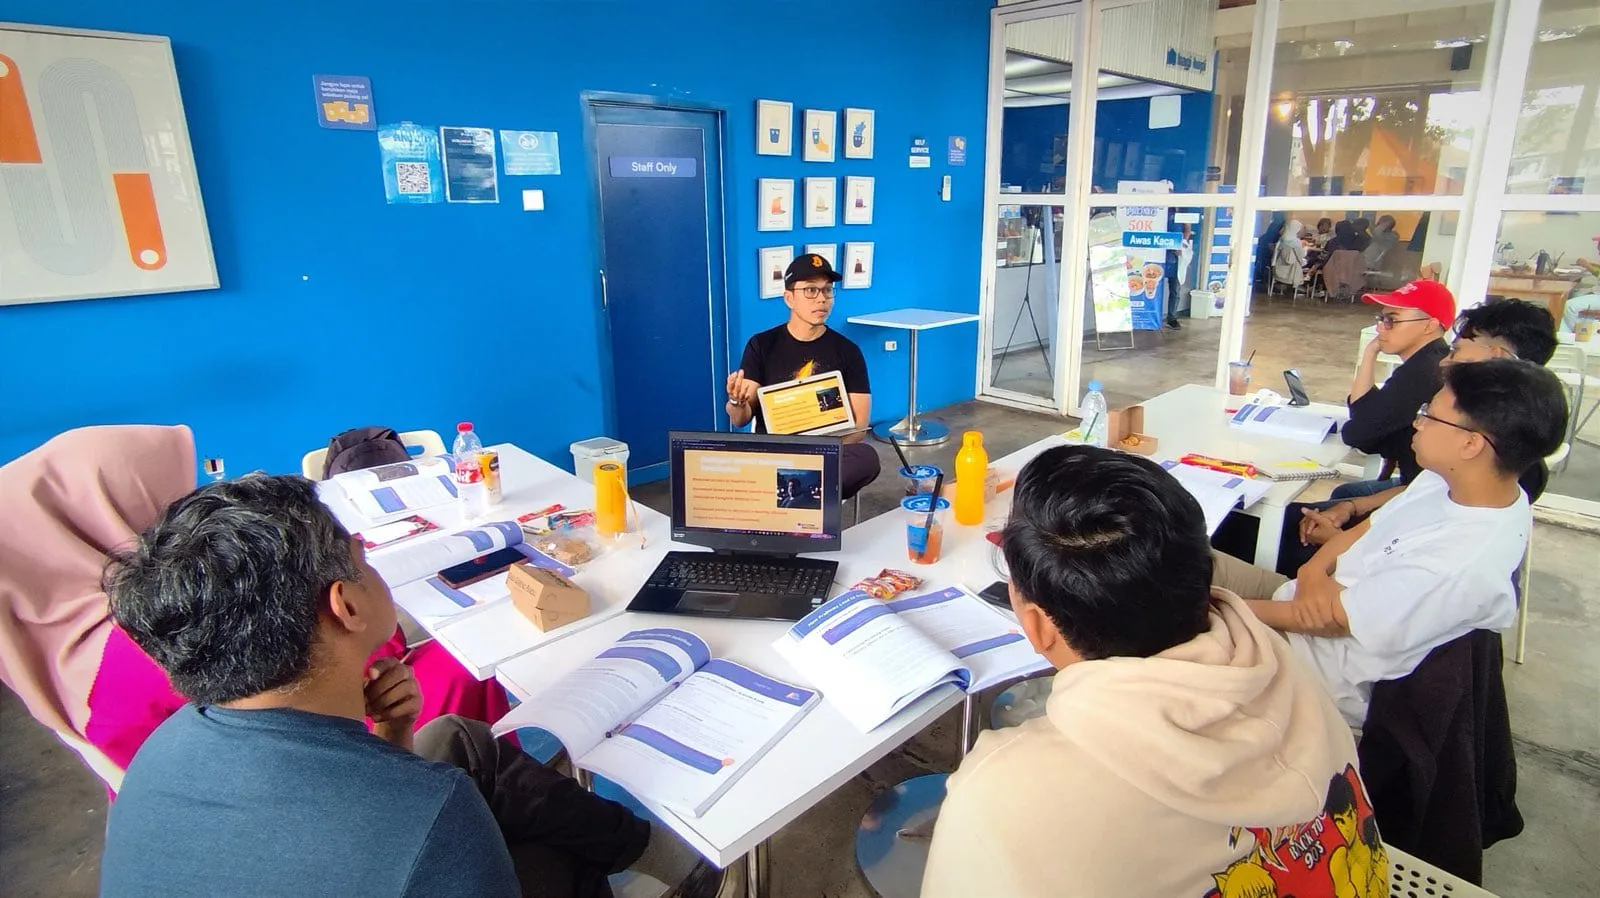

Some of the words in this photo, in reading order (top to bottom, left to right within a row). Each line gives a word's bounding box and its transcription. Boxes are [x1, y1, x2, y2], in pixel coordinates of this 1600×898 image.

[631, 161, 653, 172] Staff
[656, 161, 677, 175] Only
[1128, 219, 1153, 231] 50K
[1129, 234, 1152, 246] Awas
[1153, 235, 1175, 247] Kaca
[1289, 833, 1314, 860] BACK
[1312, 818, 1324, 836] TO
